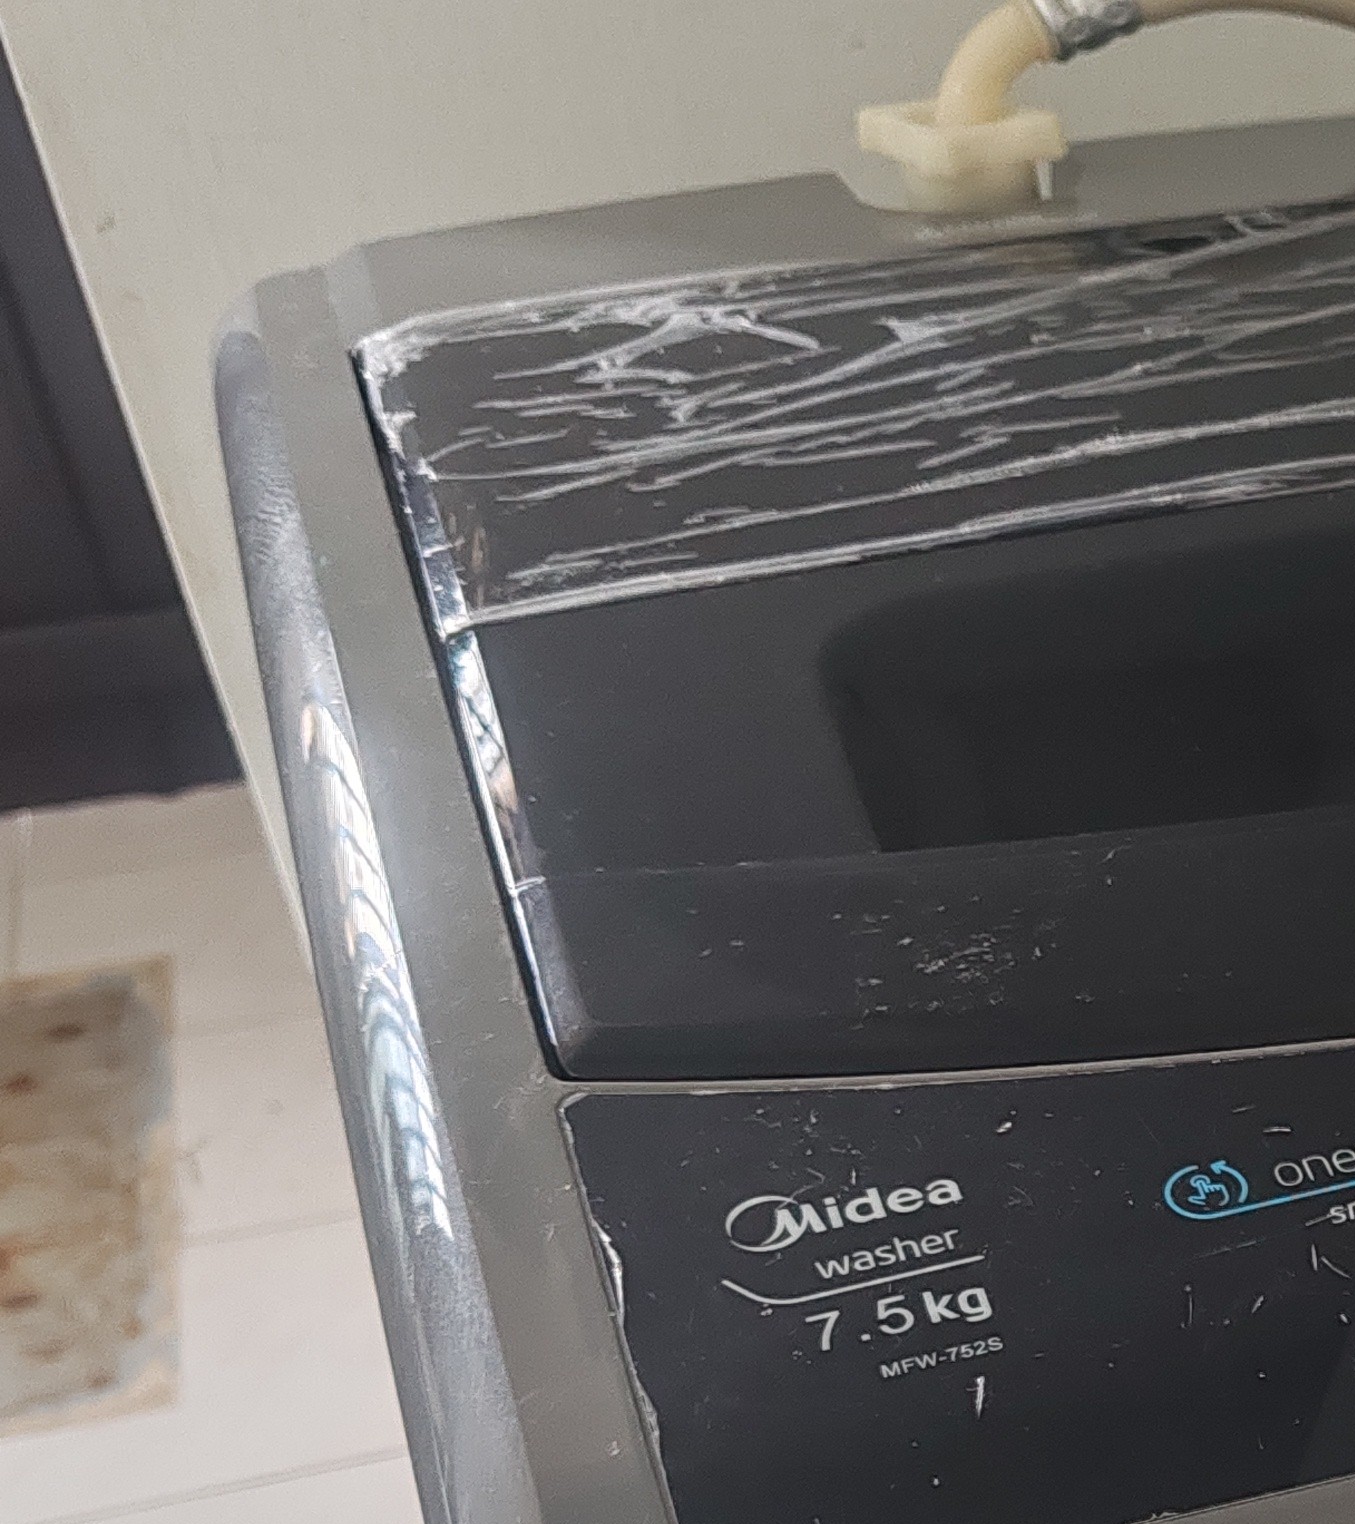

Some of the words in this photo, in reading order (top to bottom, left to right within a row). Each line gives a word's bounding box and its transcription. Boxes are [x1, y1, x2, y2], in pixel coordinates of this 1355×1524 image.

[725, 1178, 964, 1252] Midea
[813, 1228, 959, 1280] washer
[879, 1336, 1004, 1379] MFW-752S
